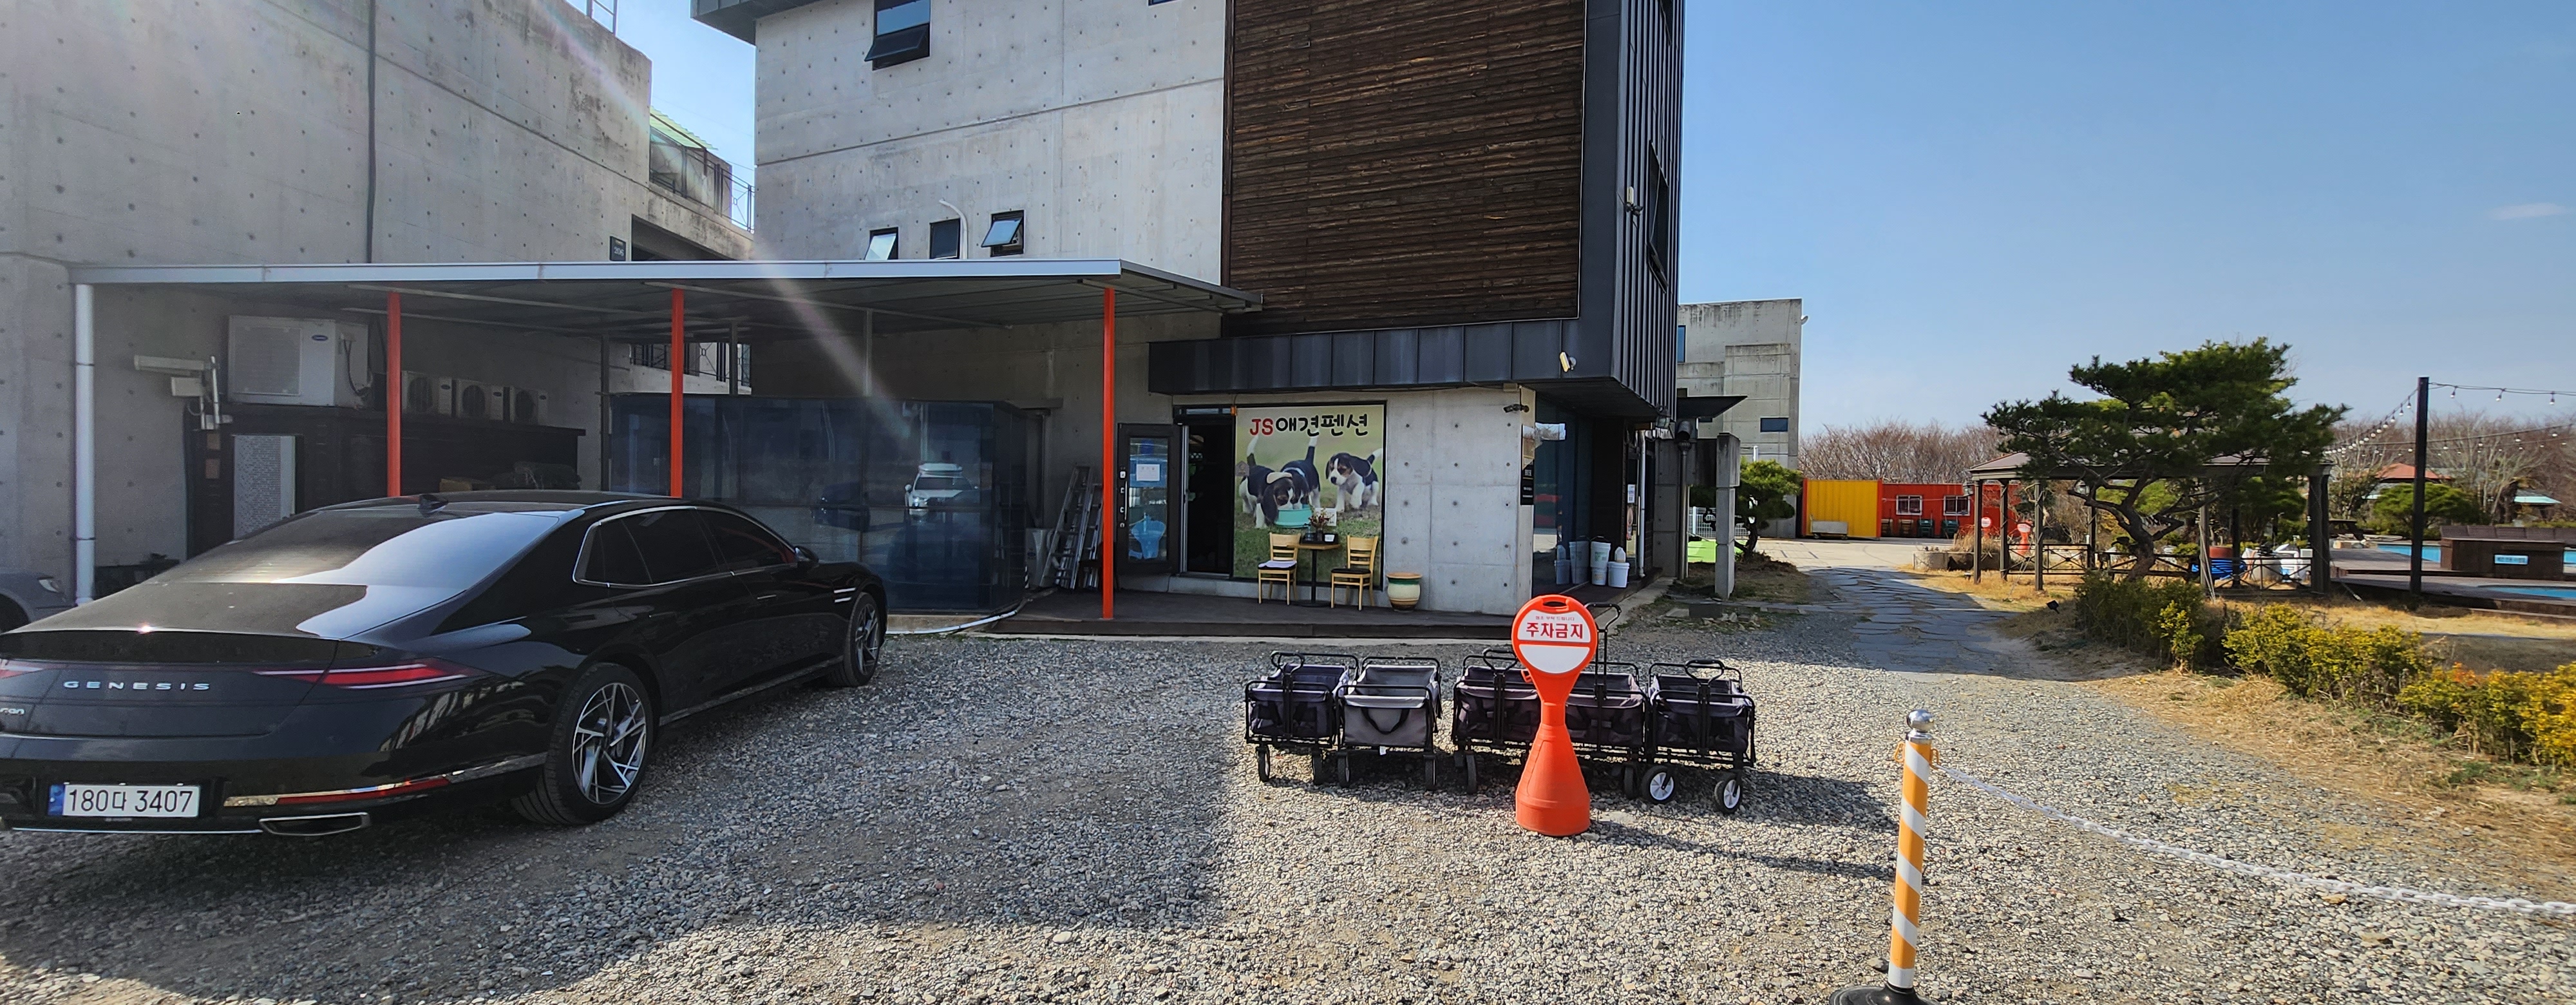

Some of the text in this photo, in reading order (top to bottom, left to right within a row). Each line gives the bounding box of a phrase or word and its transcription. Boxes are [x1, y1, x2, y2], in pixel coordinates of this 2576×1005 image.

[1249, 414, 1368, 437] JS애견펜션
[1526, 622, 1583, 639] 주차금지
[64, 681, 211, 691] GENESIS
[69, 789, 193, 812] 180다 3407
